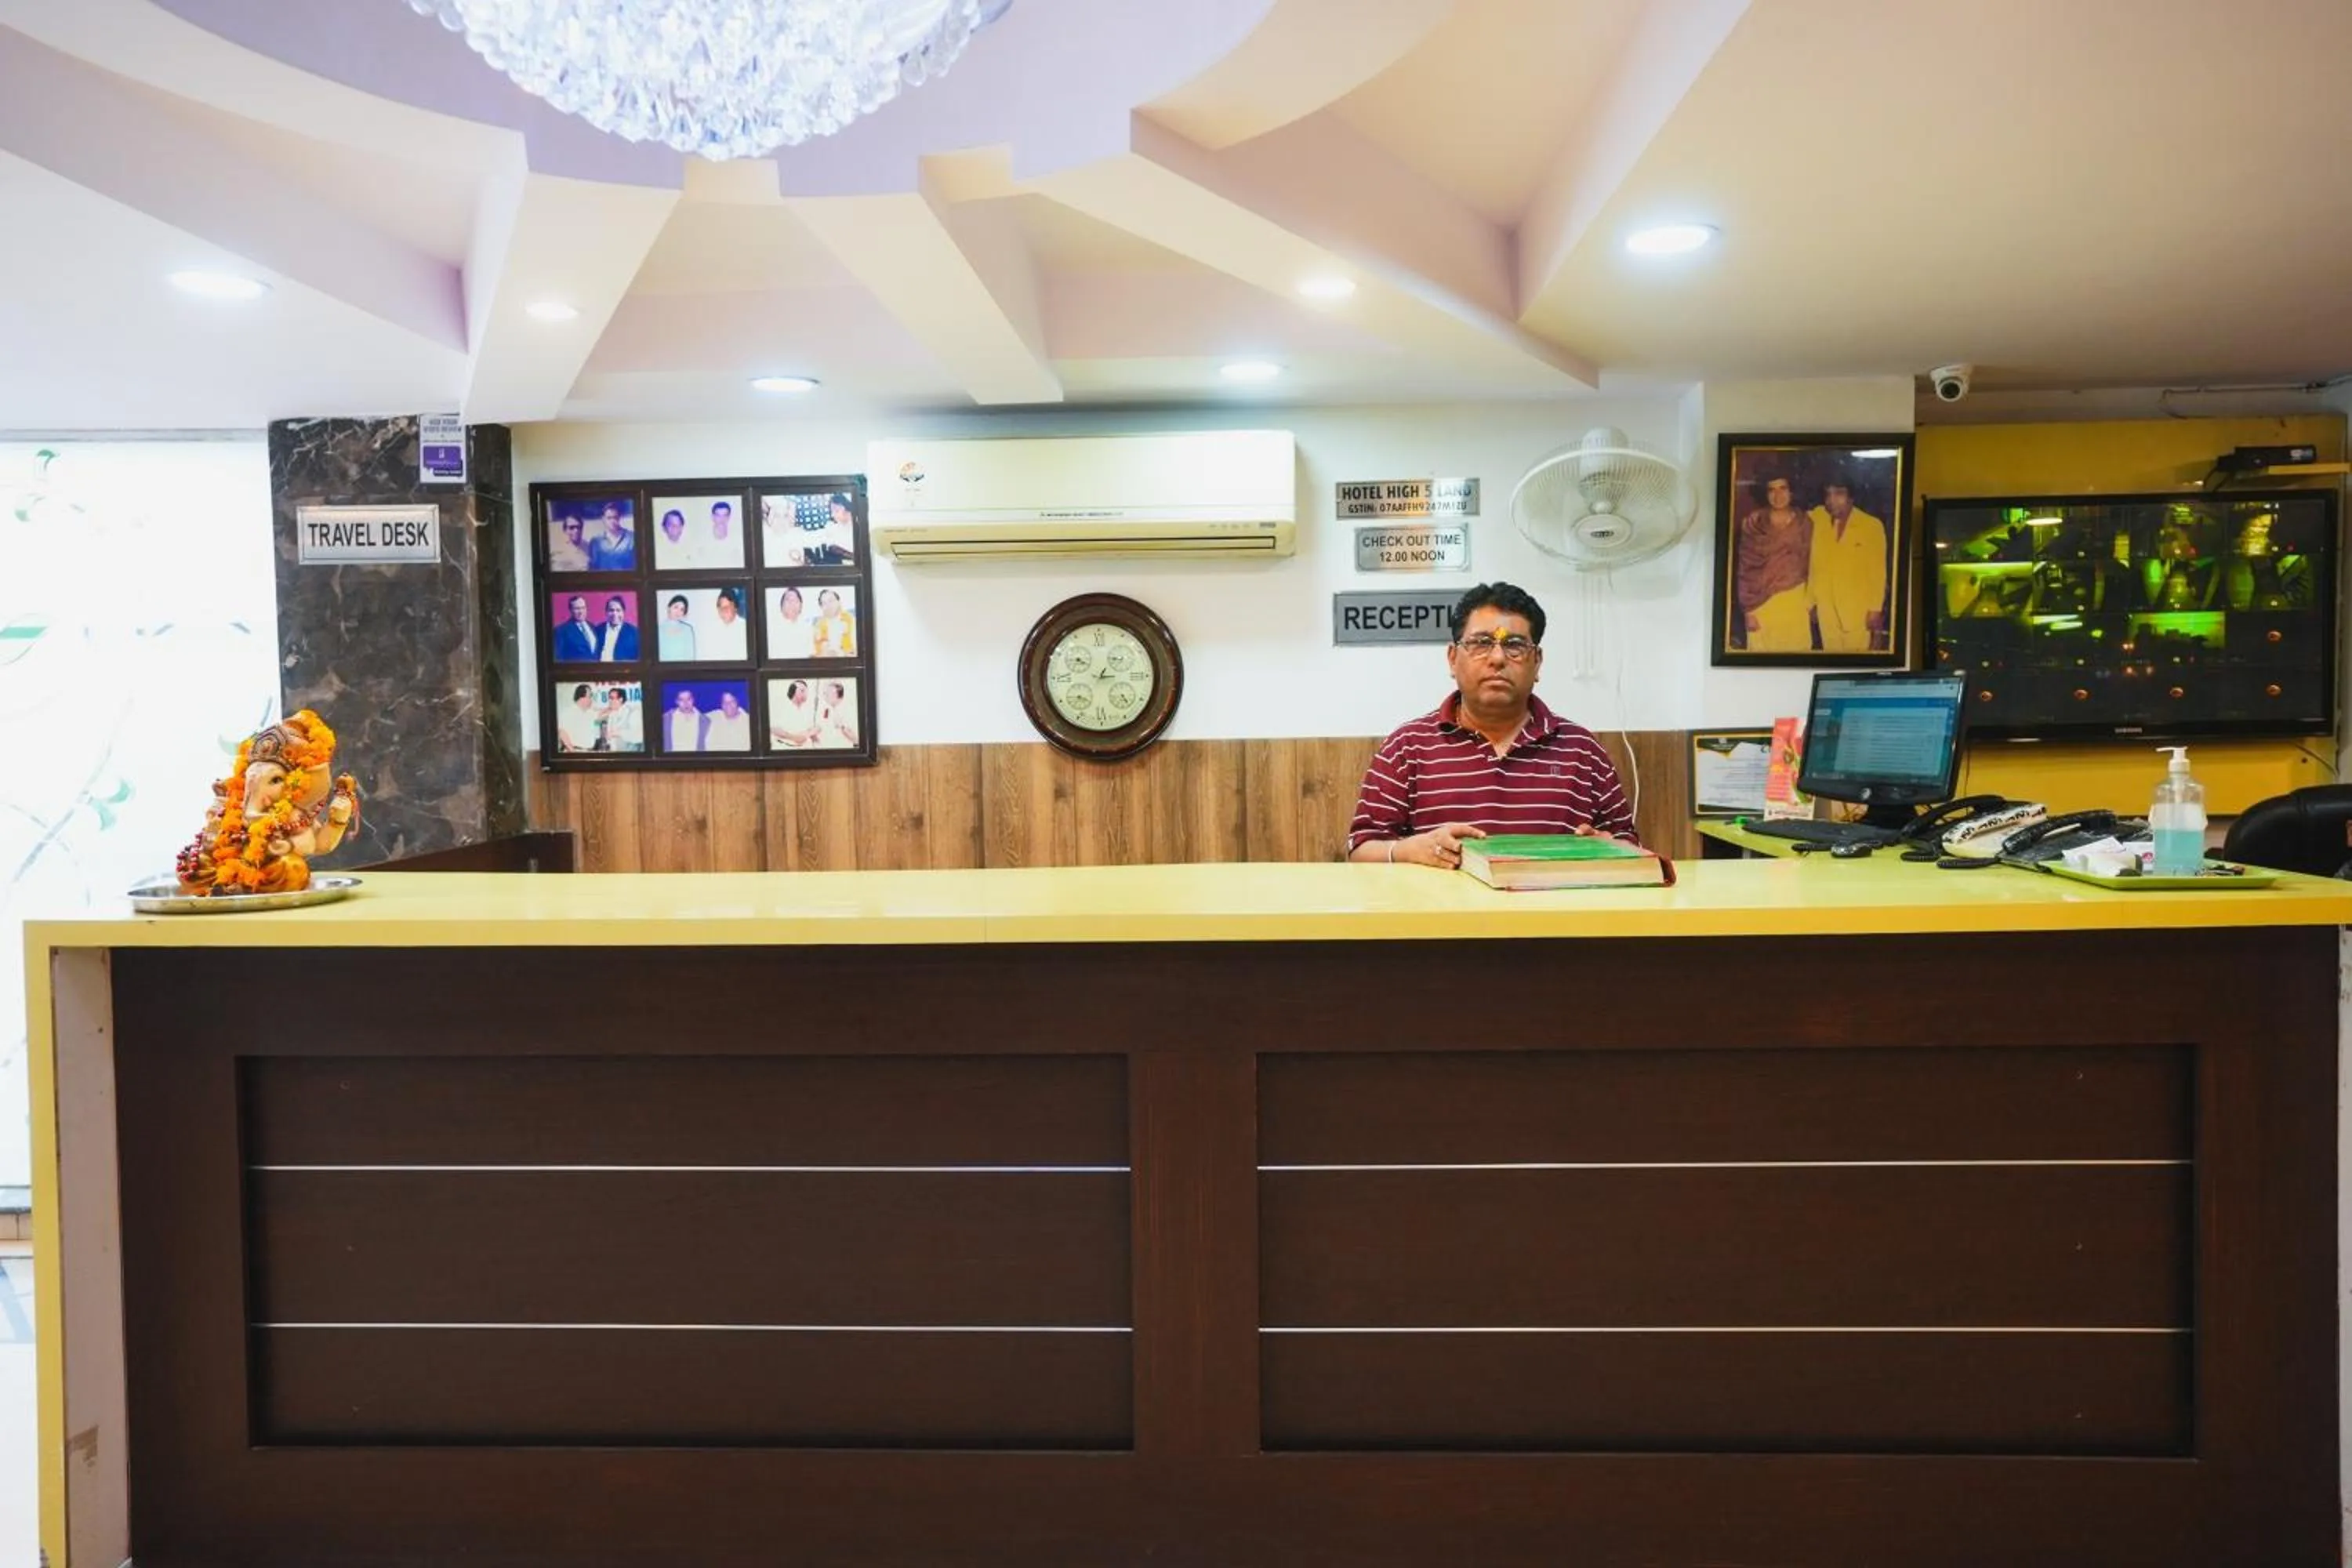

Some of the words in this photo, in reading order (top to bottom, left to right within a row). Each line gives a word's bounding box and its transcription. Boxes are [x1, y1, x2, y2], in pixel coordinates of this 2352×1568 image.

[1342, 485, 1383, 500] HOTEL
[1387, 485, 1420, 499] HIGH
[1425, 484, 1432, 497] 5
[1438, 483, 1472, 496] LAND
[307, 522, 376, 546] TRAVEL
[381, 522, 430, 546] DESK
[1362, 535, 1403, 547] CHECK
[1406, 535, 1431, 546] OUT
[1433, 534, 1462, 545] TIME
[1379, 551, 1408, 562] 12.00
[1410, 550, 1445, 561] NOON
[1344, 604, 1453, 630] RECEPTI
